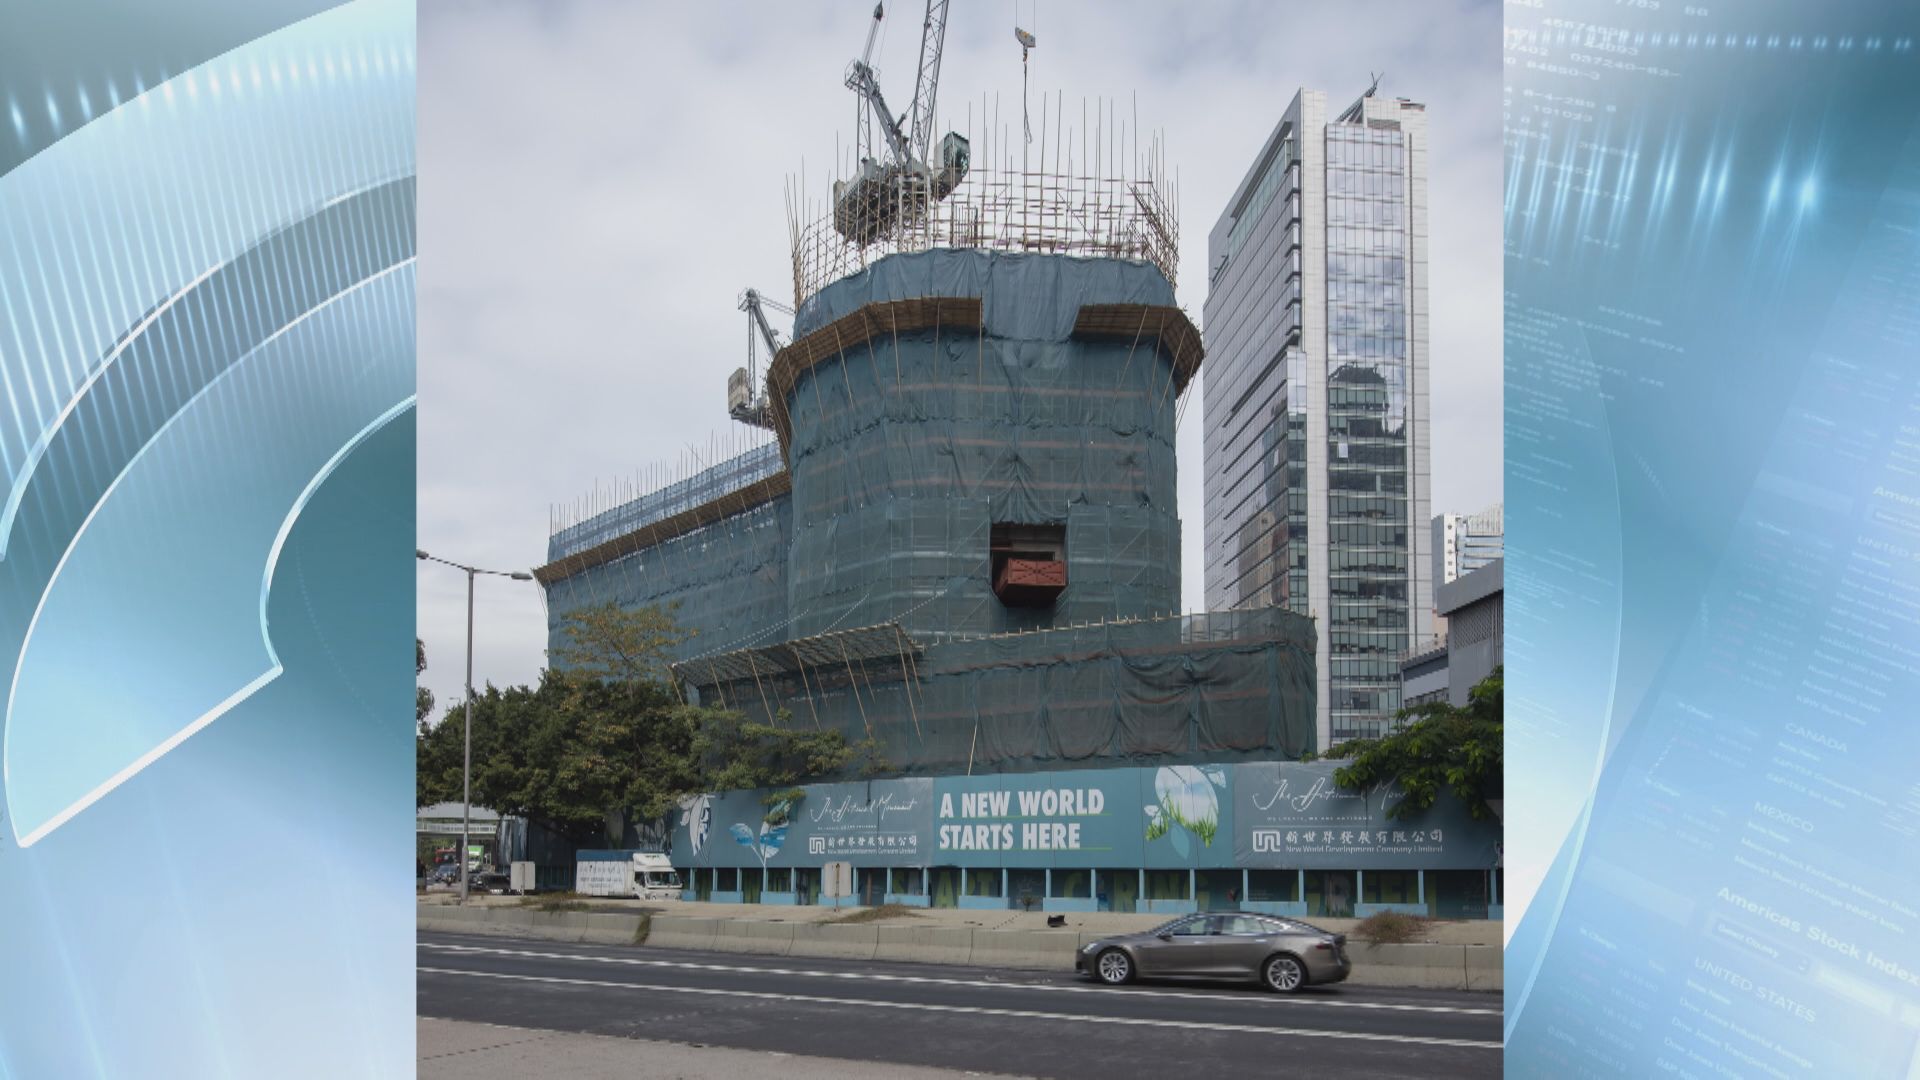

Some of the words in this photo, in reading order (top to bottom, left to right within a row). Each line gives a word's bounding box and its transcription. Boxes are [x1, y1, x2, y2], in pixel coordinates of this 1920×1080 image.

[939, 792, 955, 819] A
[961, 790, 1011, 818] NEW
[1018, 788, 1105, 817] WORLD
[939, 822, 1014, 850] STARTS
[1022, 822, 1081, 850] HERE
[1285, 829, 1443, 845] 新世界發展有限公司
[1286, 845, 1302, 853] New
[1302, 845, 1322, 853] World
